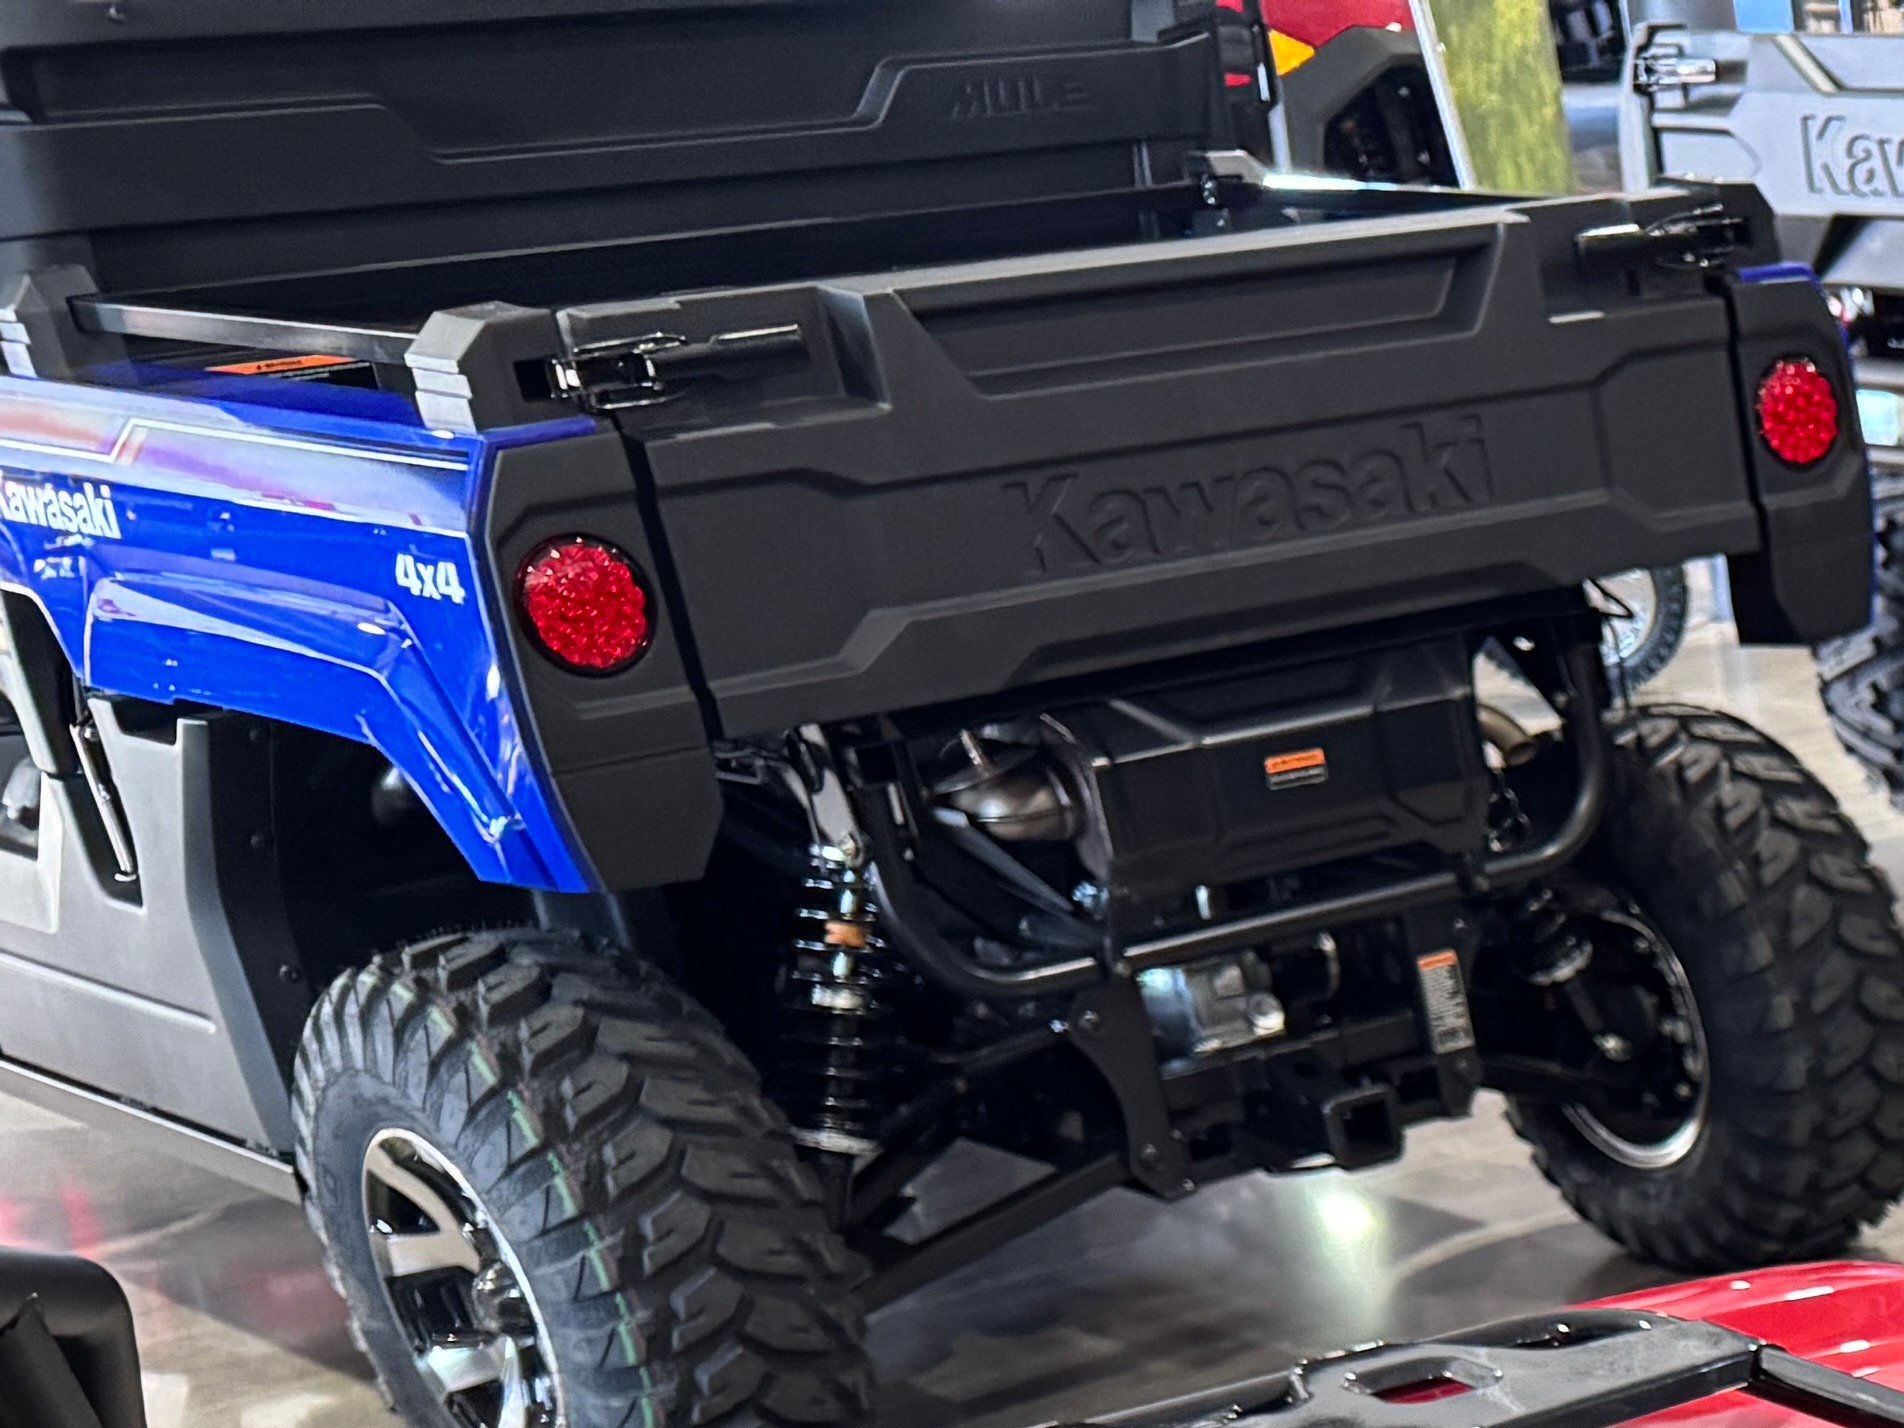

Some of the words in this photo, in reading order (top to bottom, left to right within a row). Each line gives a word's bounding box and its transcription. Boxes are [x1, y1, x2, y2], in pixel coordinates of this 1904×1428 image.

[0, 481, 122, 540] awasaki
[1000, 413, 1498, 576] Kawasaki
[394, 552, 466, 605] 4x4
